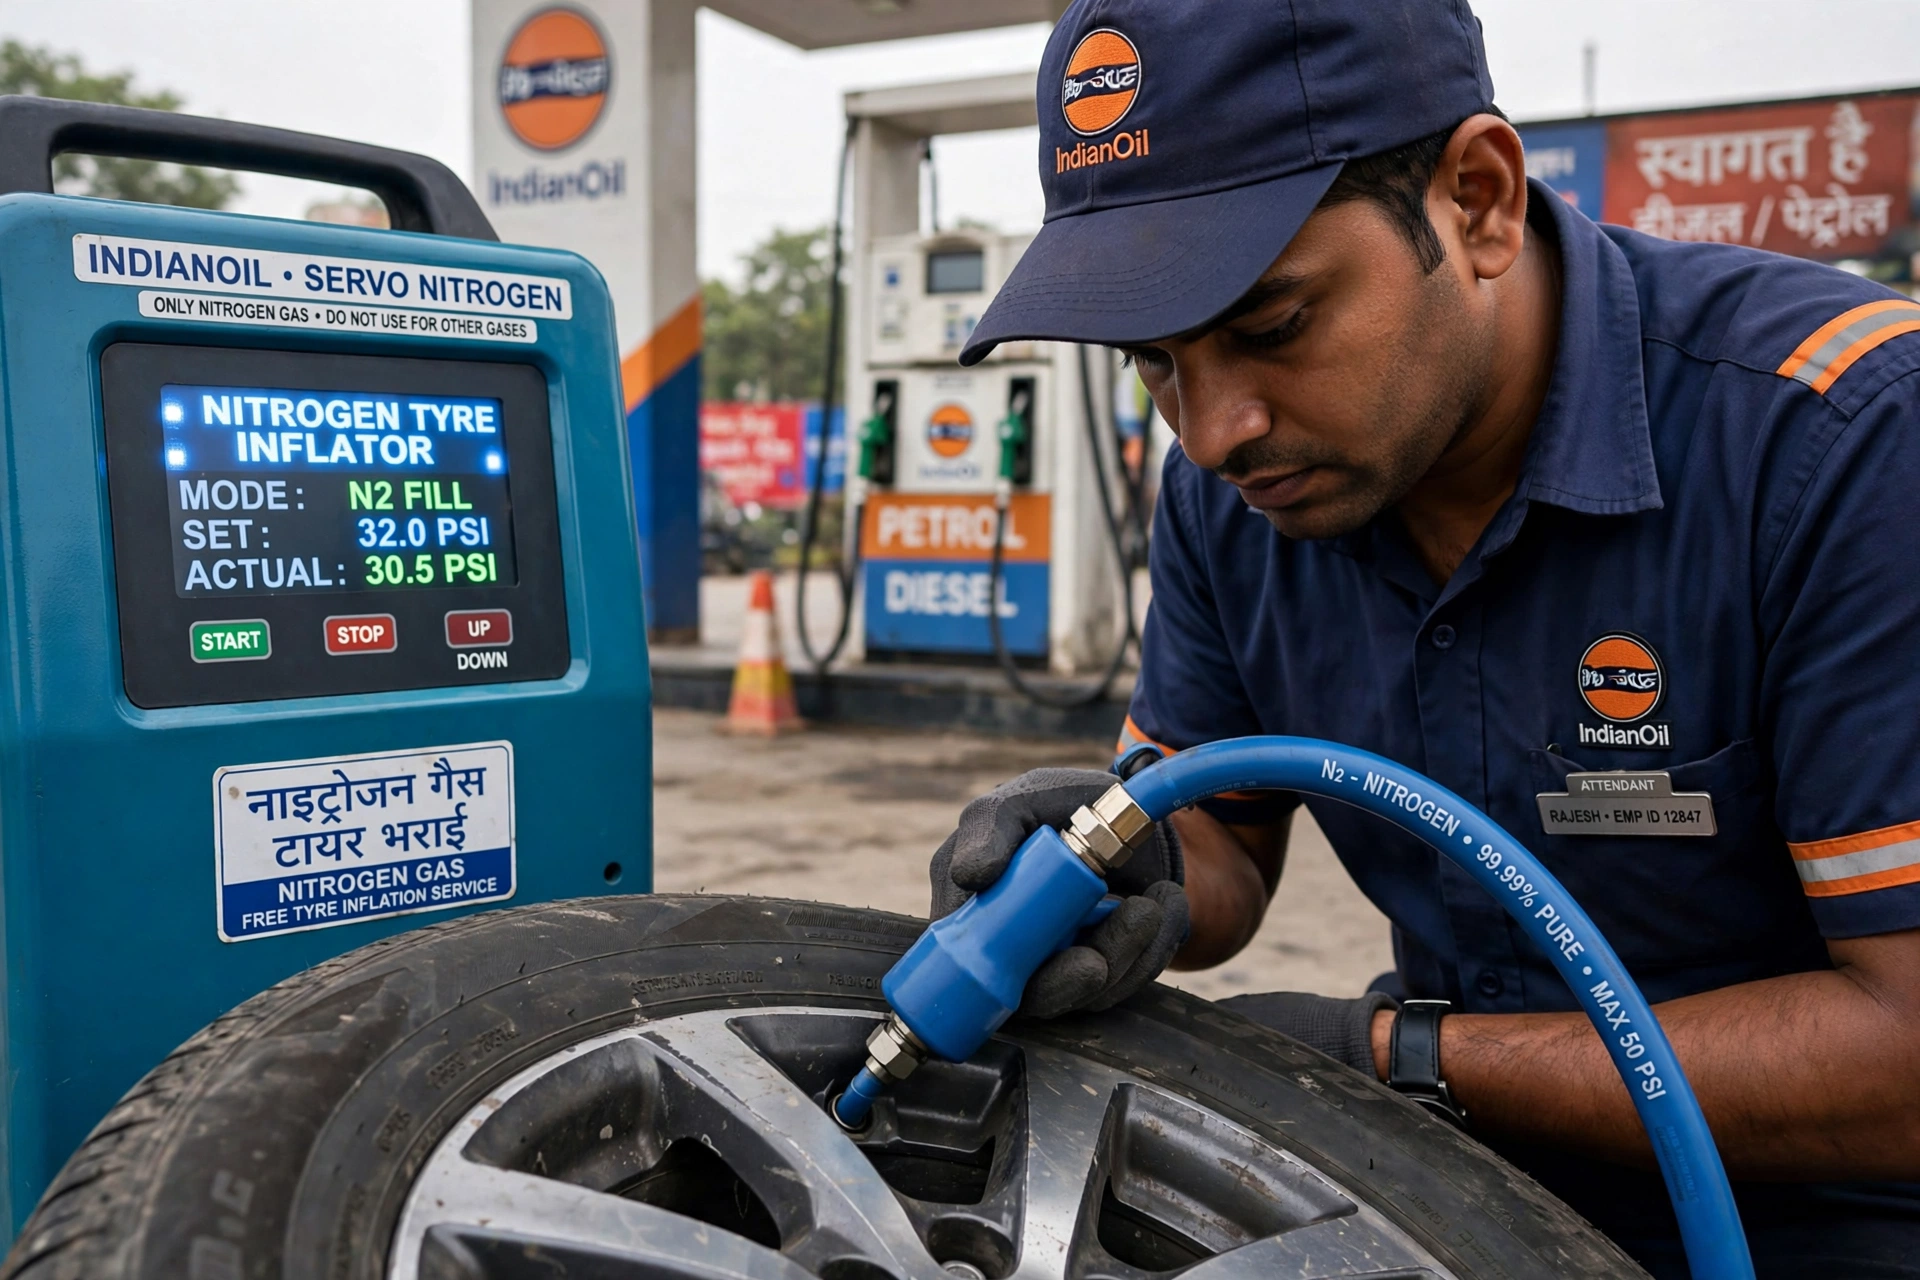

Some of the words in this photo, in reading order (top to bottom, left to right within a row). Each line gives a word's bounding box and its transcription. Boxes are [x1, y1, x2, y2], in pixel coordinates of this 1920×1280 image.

[1056, 129, 1149, 174] IndianOil
[1634, 126, 1814, 189] स्वागत
[1825, 102, 1873, 184] है
[489, 160, 626, 206] IndianOil
[89, 244, 272, 288] INDIANOIL
[305, 264, 409, 298] SERVO
[419, 274, 562, 312] NITROGEN
[154, 297, 195, 315] ONLY
[199, 300, 276, 320] NITROGEN
[280, 306, 309, 323] GAS
[326, 309, 346, 325] DO
[350, 311, 377, 327] NOT
[381, 313, 408, 329] USE
[411, 316, 438, 332] FOR
[441, 318, 484, 335] OTHER
[486, 321, 527, 338] GASES
[202, 395, 401, 430] NITROGEN
[409, 404, 496, 434] TYRE
[236, 432, 435, 465] INFLATOR
[348, 481, 394, 510] N2
[404, 481, 473, 510] FILL
[358, 517, 426, 547] 32.0
[438, 517, 489, 546] PSI
[877, 504, 1027, 549] PETROL
[365, 555, 434, 585] 30.5
[444, 553, 497, 583] PSI
[885, 569, 1019, 618] DIESEL
[201, 631, 261, 651] START
[337, 625, 385, 644] STOP
[467, 620, 491, 637] UP
[457, 651, 508, 670] DOWN
[1579, 723, 1670, 746] IndianOil
[246, 769, 416, 824] नाइट्रोजन
[428, 757, 487, 799] गैस
[1581, 780, 1655, 791] ATTENDANT
[272, 826, 366, 868] टायर
[381, 802, 468, 851] भराई
[1550, 810, 1601, 823] RAJESH
[1614, 810, 1643, 823] EMP
[1647, 810, 1660, 823] ID
[1664, 810, 1701, 823] 12847
[278, 866, 408, 903] NITROGEN
[416, 858, 465, 882] GAS
[242, 908, 288, 929] FREE
[293, 901, 337, 921] TYRE
[342, 888, 427, 913] INFLATION
[431, 877, 497, 900] SERVICE
[1363, 771, 1461, 837] NITROGEN
[1476, 844, 1538, 908] 99.99%
[1535, 903, 1585, 962] PURE
[1590, 980, 1630, 1031] MAX
[1620, 1032, 1645, 1059] 50
[1634, 1061, 1666, 1100] PSI
